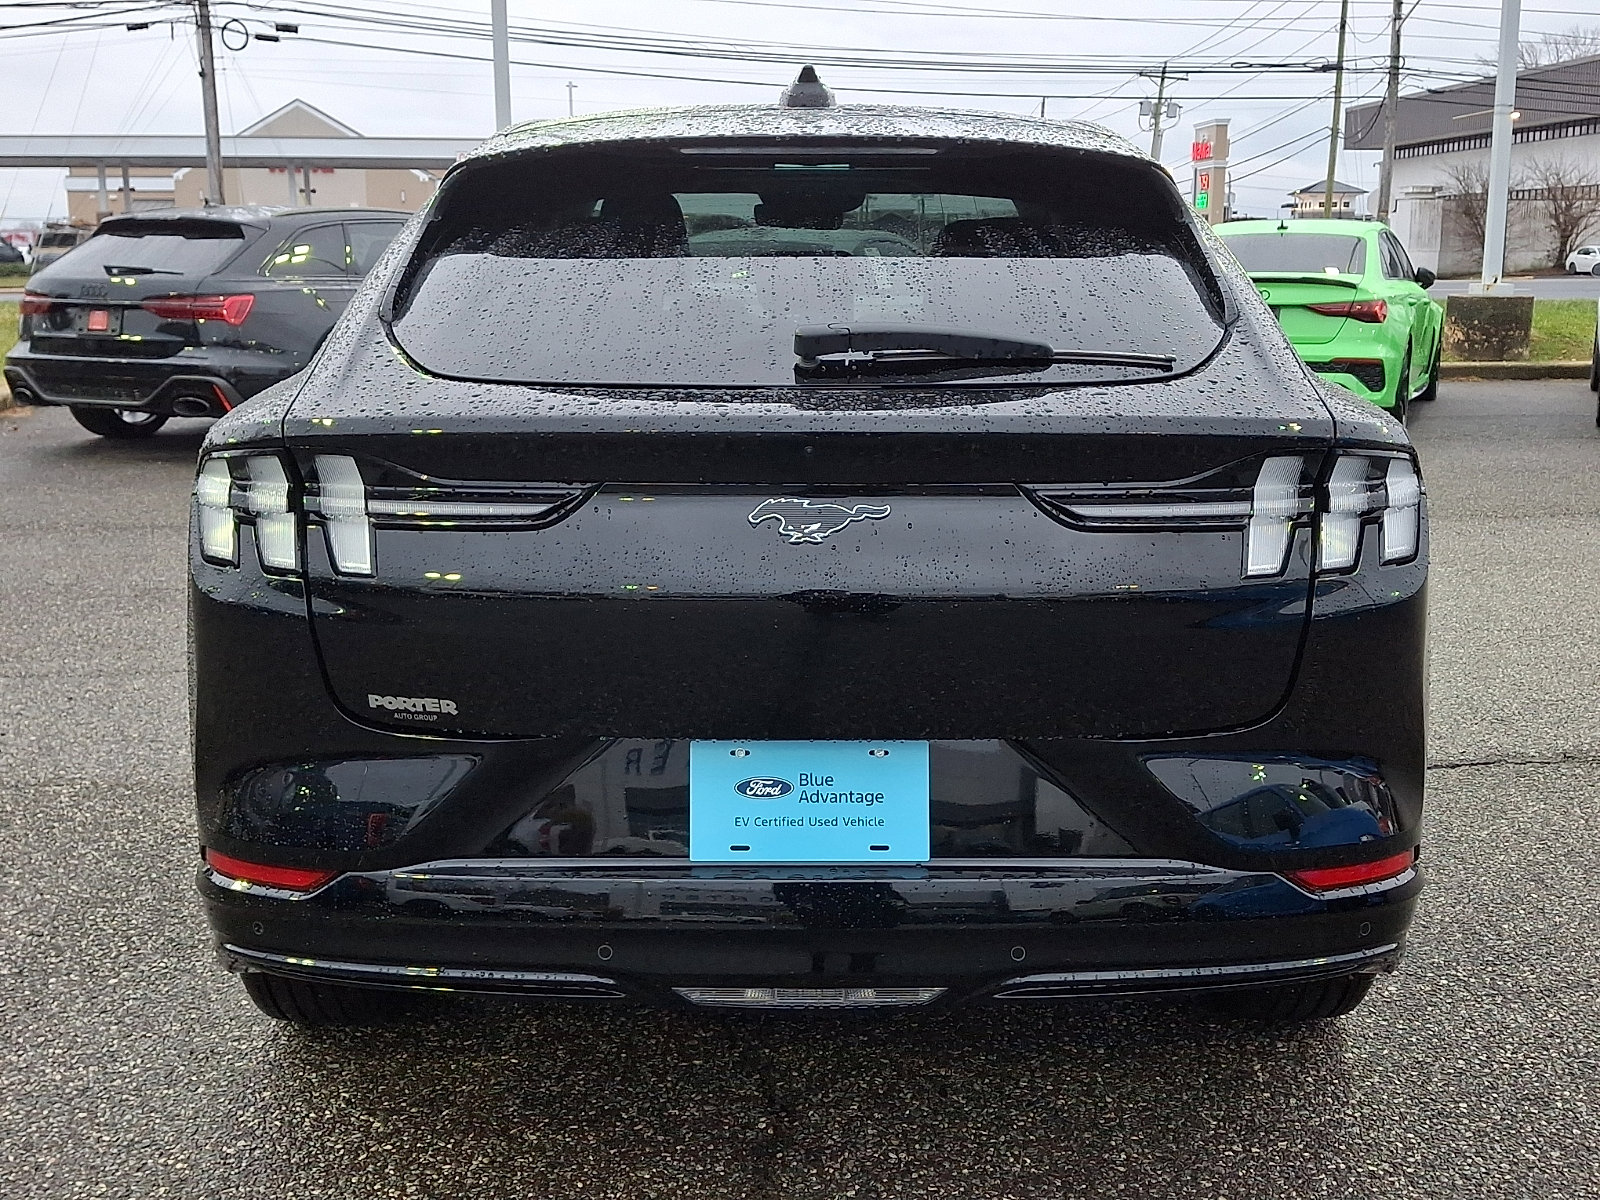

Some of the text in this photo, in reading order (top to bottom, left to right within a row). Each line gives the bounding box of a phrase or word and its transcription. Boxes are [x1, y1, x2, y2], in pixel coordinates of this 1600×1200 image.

[368, 694, 458, 716] PORTER
[746, 780, 782, 796] Ford
[799, 773, 834, 787] Blue
[799, 790, 884, 806] Advantage
[735, 816, 885, 827] EV Certified Used Vehicle
